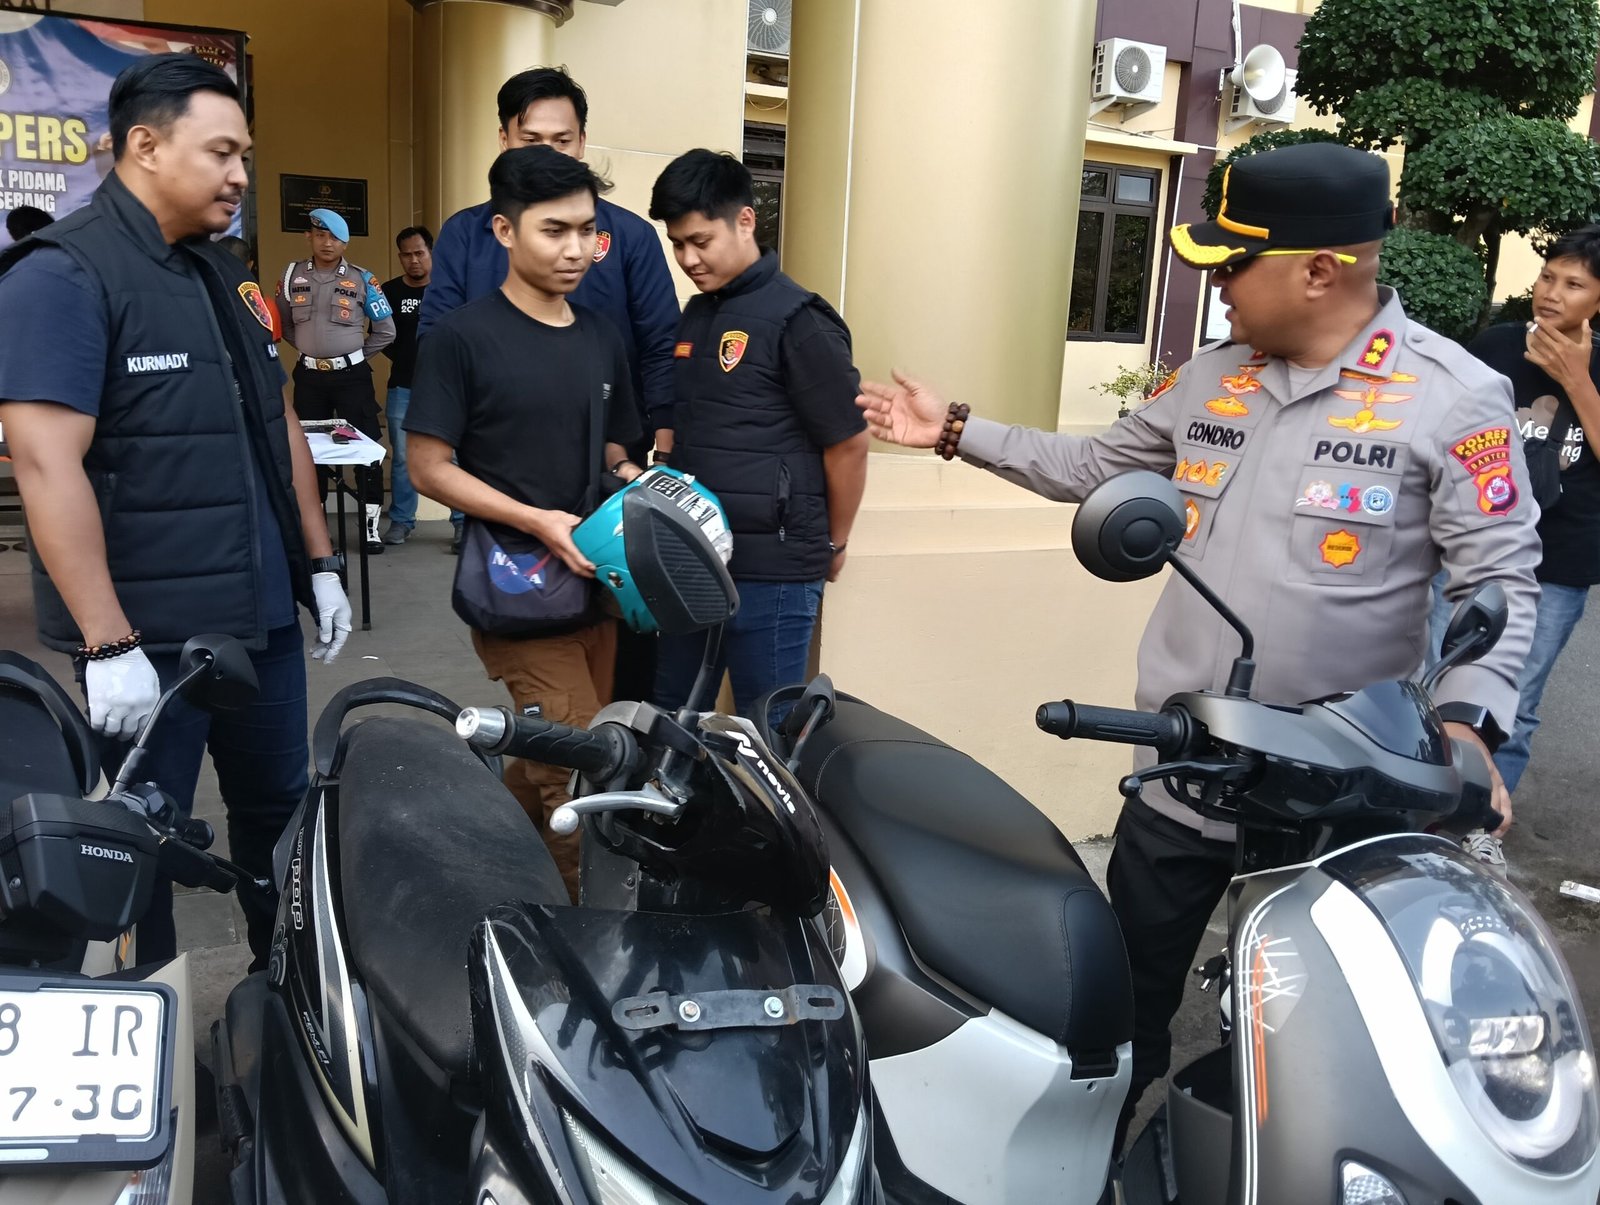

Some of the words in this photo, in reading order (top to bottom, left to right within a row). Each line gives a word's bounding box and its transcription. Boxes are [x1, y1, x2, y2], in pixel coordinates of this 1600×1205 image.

[0, 113, 87, 163] PERS
[8, 170, 67, 192] PIDANA
[334, 287, 357, 299] POLRI
[1187, 421, 1245, 450] CONDRO
[1455, 429, 1508, 456] POLRES
[1314, 440, 1397, 469] POLRI
[1470, 453, 1507, 470] BANTEN
[80, 844, 134, 863] HONDA
[72, 1004, 143, 1056] IR
